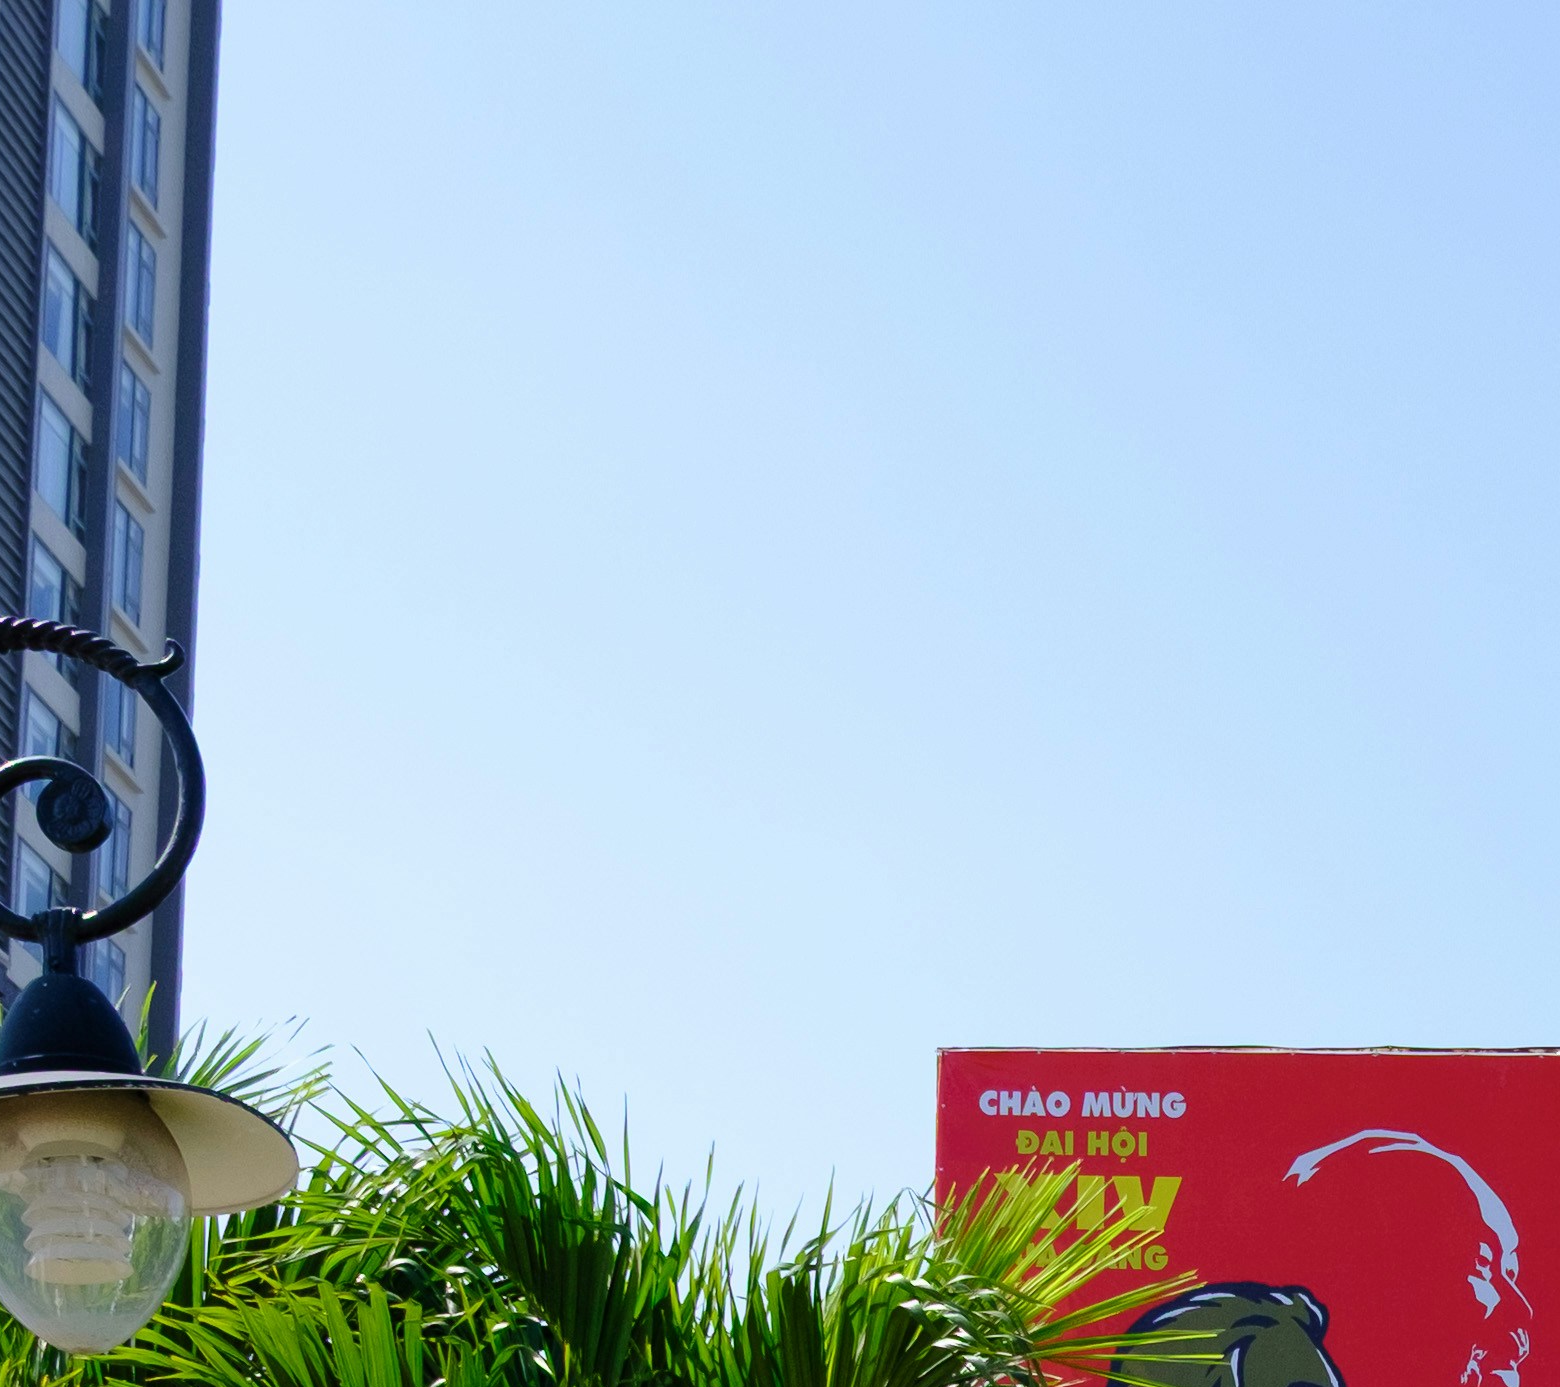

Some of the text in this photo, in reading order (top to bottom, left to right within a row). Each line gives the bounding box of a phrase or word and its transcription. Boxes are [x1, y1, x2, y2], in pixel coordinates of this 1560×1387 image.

[978, 1085, 1187, 1119] CHÀO MỪNG
[1087, 1126, 1148, 1163] HỘI
